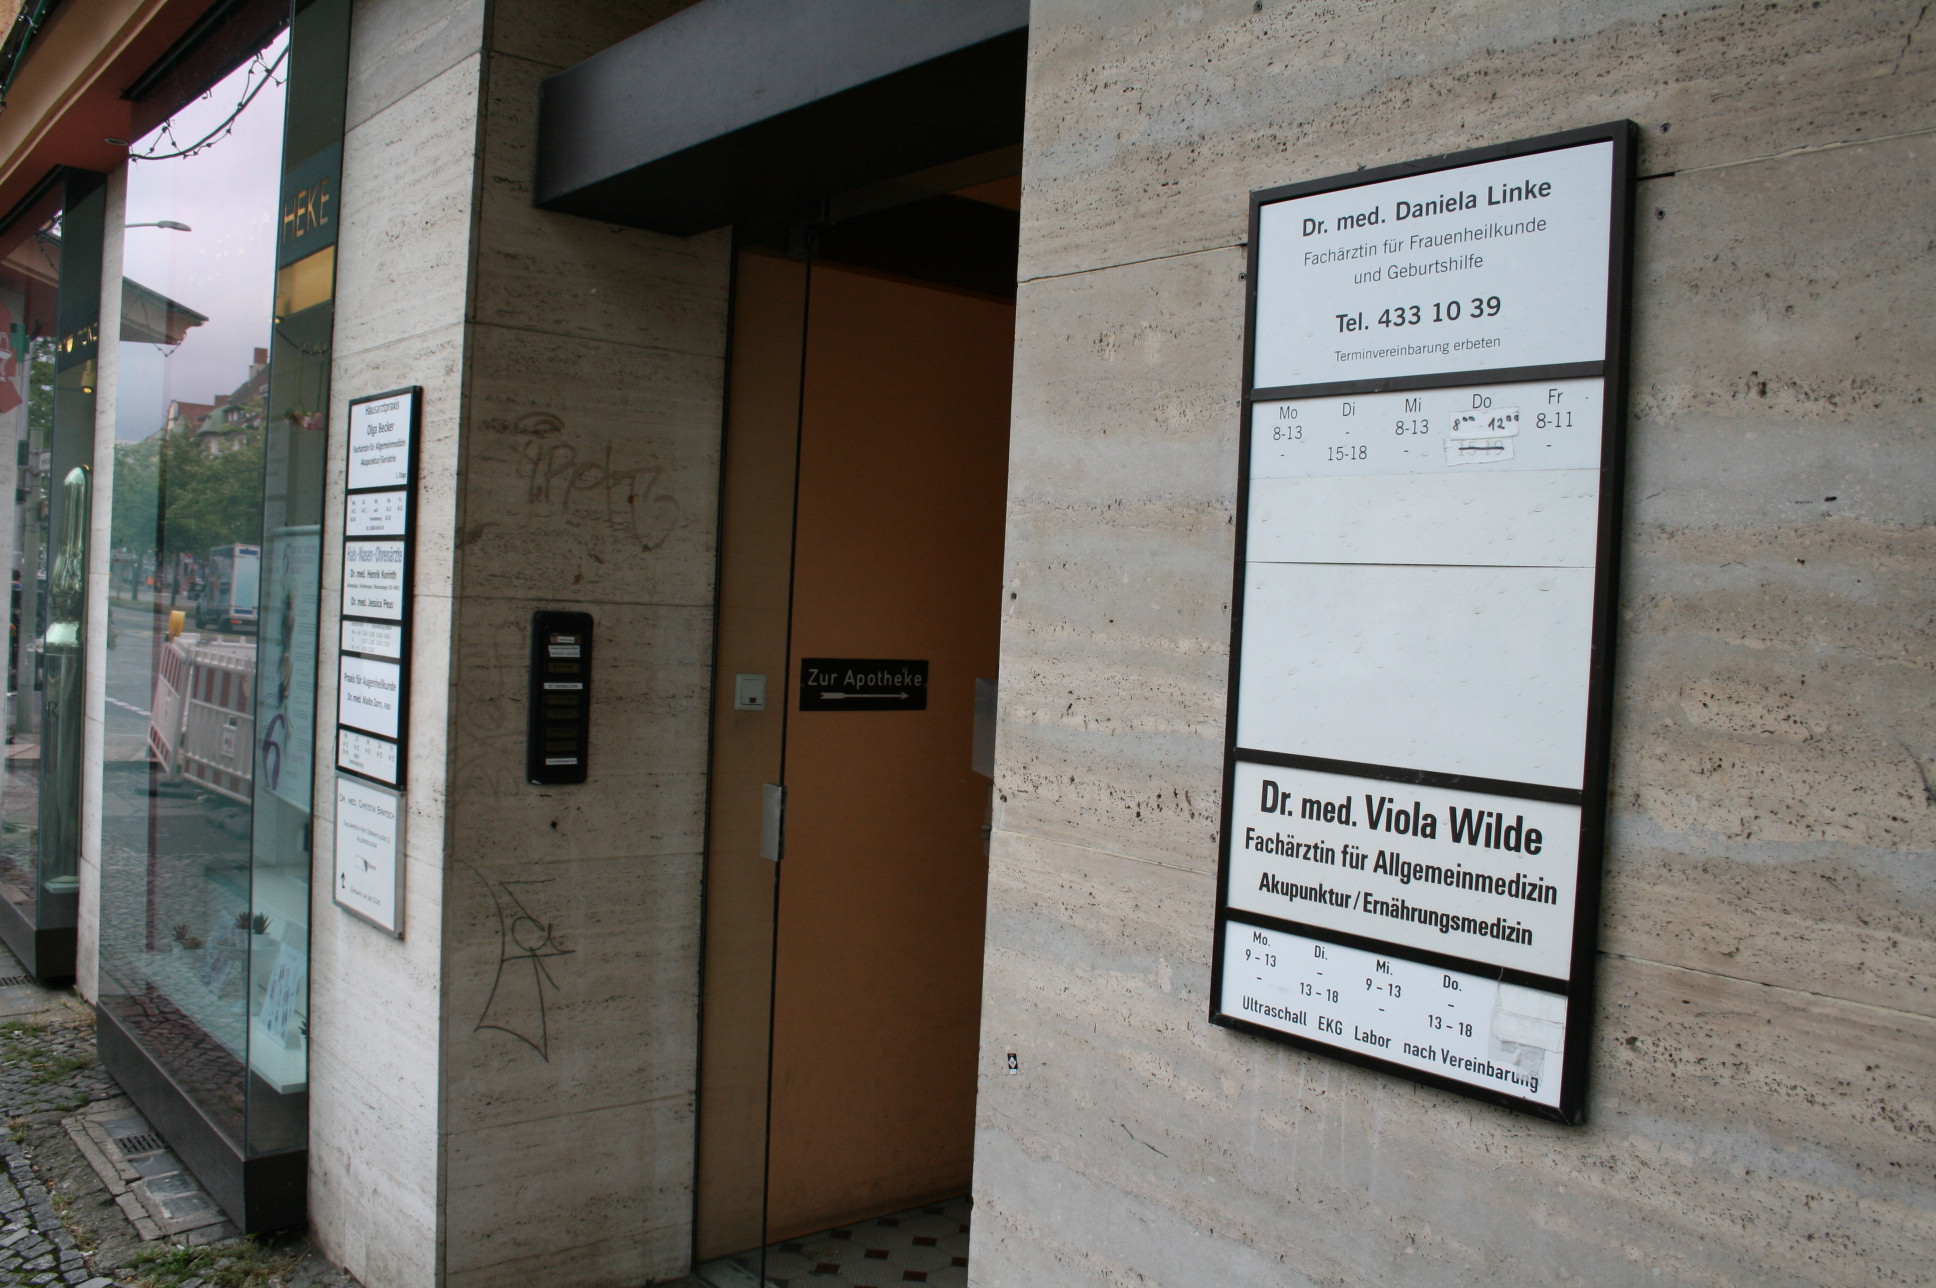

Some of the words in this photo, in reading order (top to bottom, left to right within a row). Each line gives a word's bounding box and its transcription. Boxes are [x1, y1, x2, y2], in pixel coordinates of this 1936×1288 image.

[1303, 218, 1327, 236] Dr.
[1337, 206, 1385, 231] med.
[1396, 191, 1476, 221] Daniela
[1488, 180, 1551, 206] Linke
[1305, 243, 1376, 266] Fachärztin
[1383, 239, 1404, 253] für
[1410, 217, 1546, 250] Frauenheilkunde
[1355, 267, 1381, 284] und
[1388, 254, 1483, 279] Geburtshilfe
[1336, 312, 1368, 332] Tel.
[1378, 306, 1420, 327] 433
[1433, 301, 1460, 322] 10
[1470, 296, 1500, 318] 39
[1335, 339, 1450, 363] Terminvereinbarung
[1453, 335, 1501, 352] erbeten
[1280, 406, 1297, 419] Mo
[1343, 402, 1355, 416] Di
[1405, 398, 1421, 412] Mi
[1473, 394, 1491, 409] Do
[1549, 389, 1563, 404] Fr
[367, 423, 378, 437] Olga
[378, 420, 395, 434] Becker
[1273, 426, 1302, 440] 8-13
[1396, 419, 1428, 435] 8-13
[1536, 412, 1572, 428] 8-11
[1328, 445, 1367, 461] 15-18
[807, 668, 838, 686] Zur
[844, 669, 923, 690] Apotheke
[1261, 780, 1292, 816] Dr.
[1301, 796, 1356, 827] med.
[1365, 794, 1437, 839] Viola
[1449, 806, 1542, 855] Wilde
[1246, 827, 1335, 865] Fachärztin
[1341, 844, 1368, 870] für
[1373, 849, 1558, 905] Allgemeinmedizin
[1253, 931, 1270, 946] Mo.
[1315, 945, 1327, 960] Di.
[1376, 960, 1392, 975] Mi.
[1443, 975, 1461, 991] Do.
[1242, 995, 1307, 1026] Ultraschall
[1318, 1016, 1342, 1035] EKG
[1355, 1026, 1391, 1048] Labor
[1404, 1043, 1436, 1061] nach
[1441, 1048, 1538, 1093] Vereinbarung
